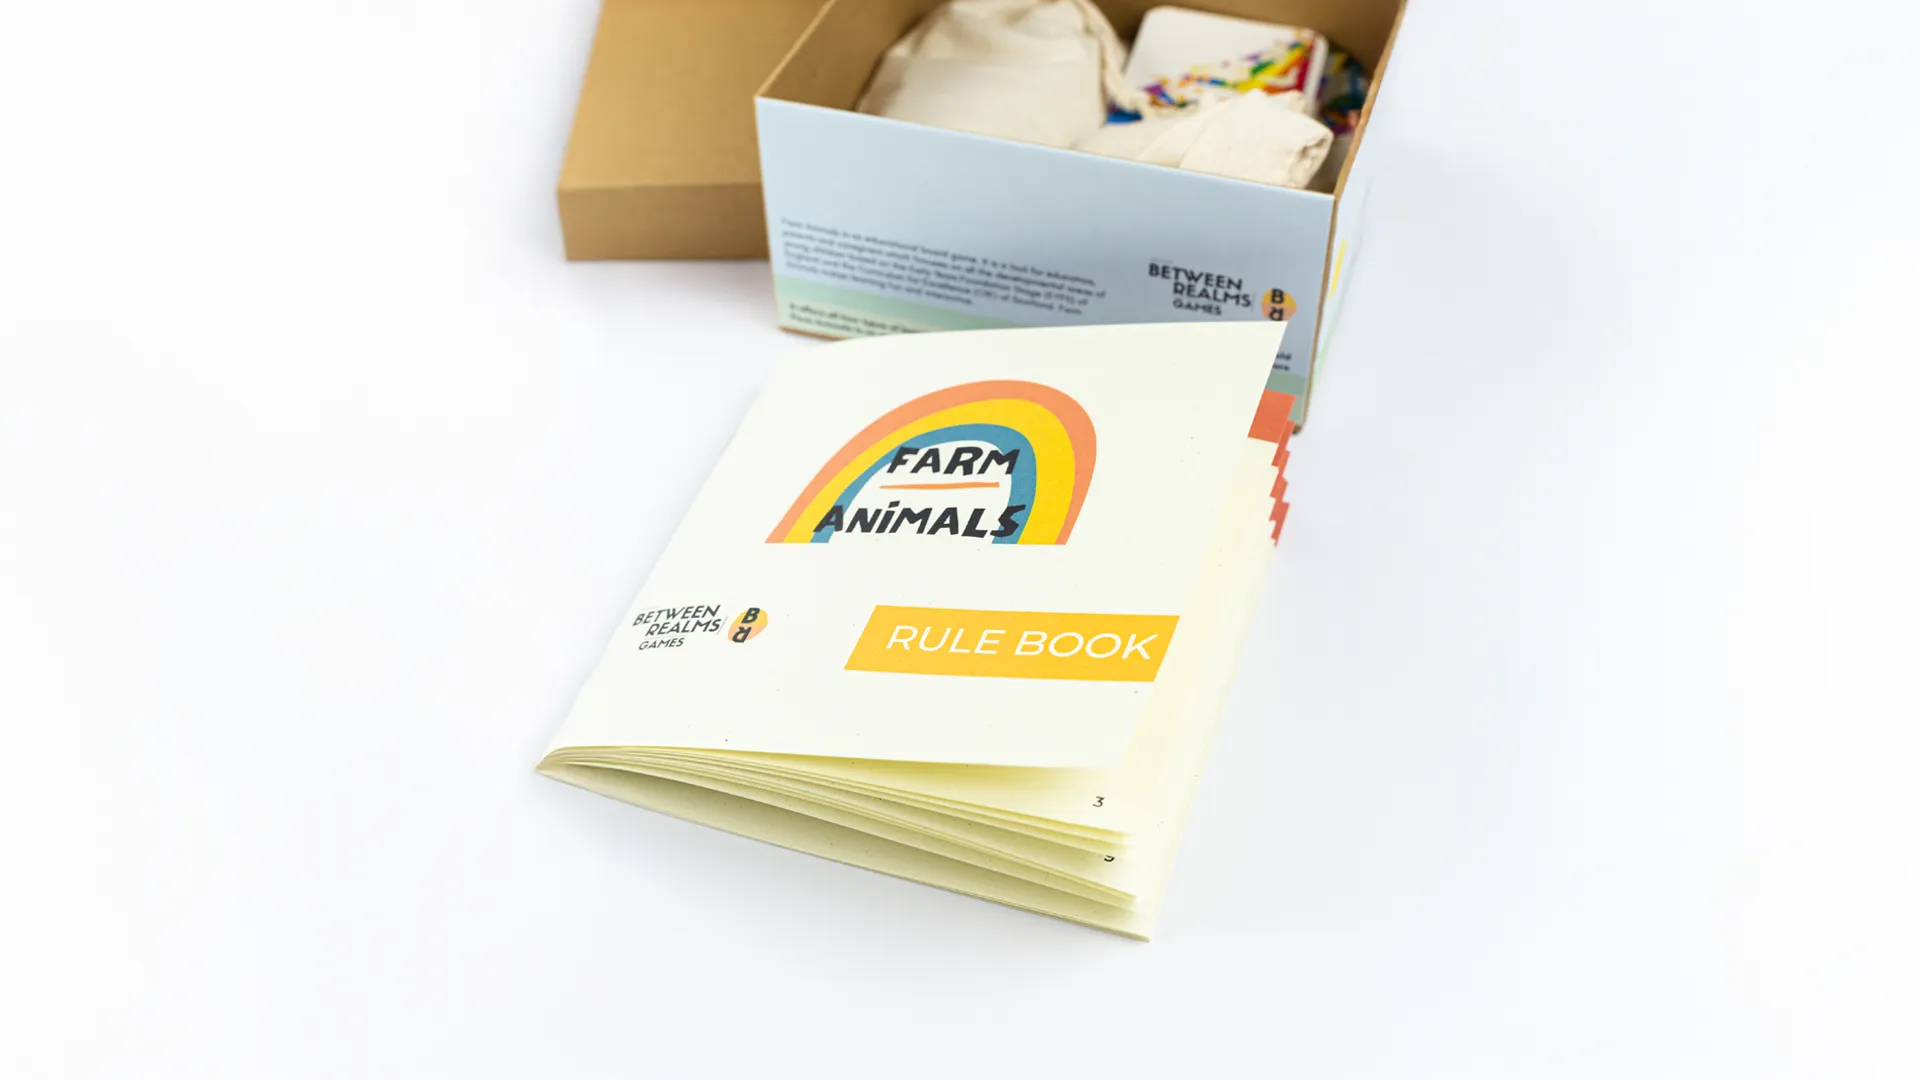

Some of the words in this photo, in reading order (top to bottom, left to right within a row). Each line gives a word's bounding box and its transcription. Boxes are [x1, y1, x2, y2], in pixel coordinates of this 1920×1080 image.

[1148, 263, 1242, 290] BETWEEN
[1173, 282, 1251, 308] REALMS
[1271, 288, 1285, 304] B
[1172, 299, 1222, 316] GAMES
[886, 446, 1020, 476] FARM
[632, 604, 720, 626] BETWEEN
[742, 608, 760, 624] B
[645, 619, 722, 636] REALMS
[638, 638, 684, 650] GAMES
[886, 626, 1006, 655] RULE
[1014, 630, 1159, 660] BOOK
[1092, 796, 1104, 807] 3
